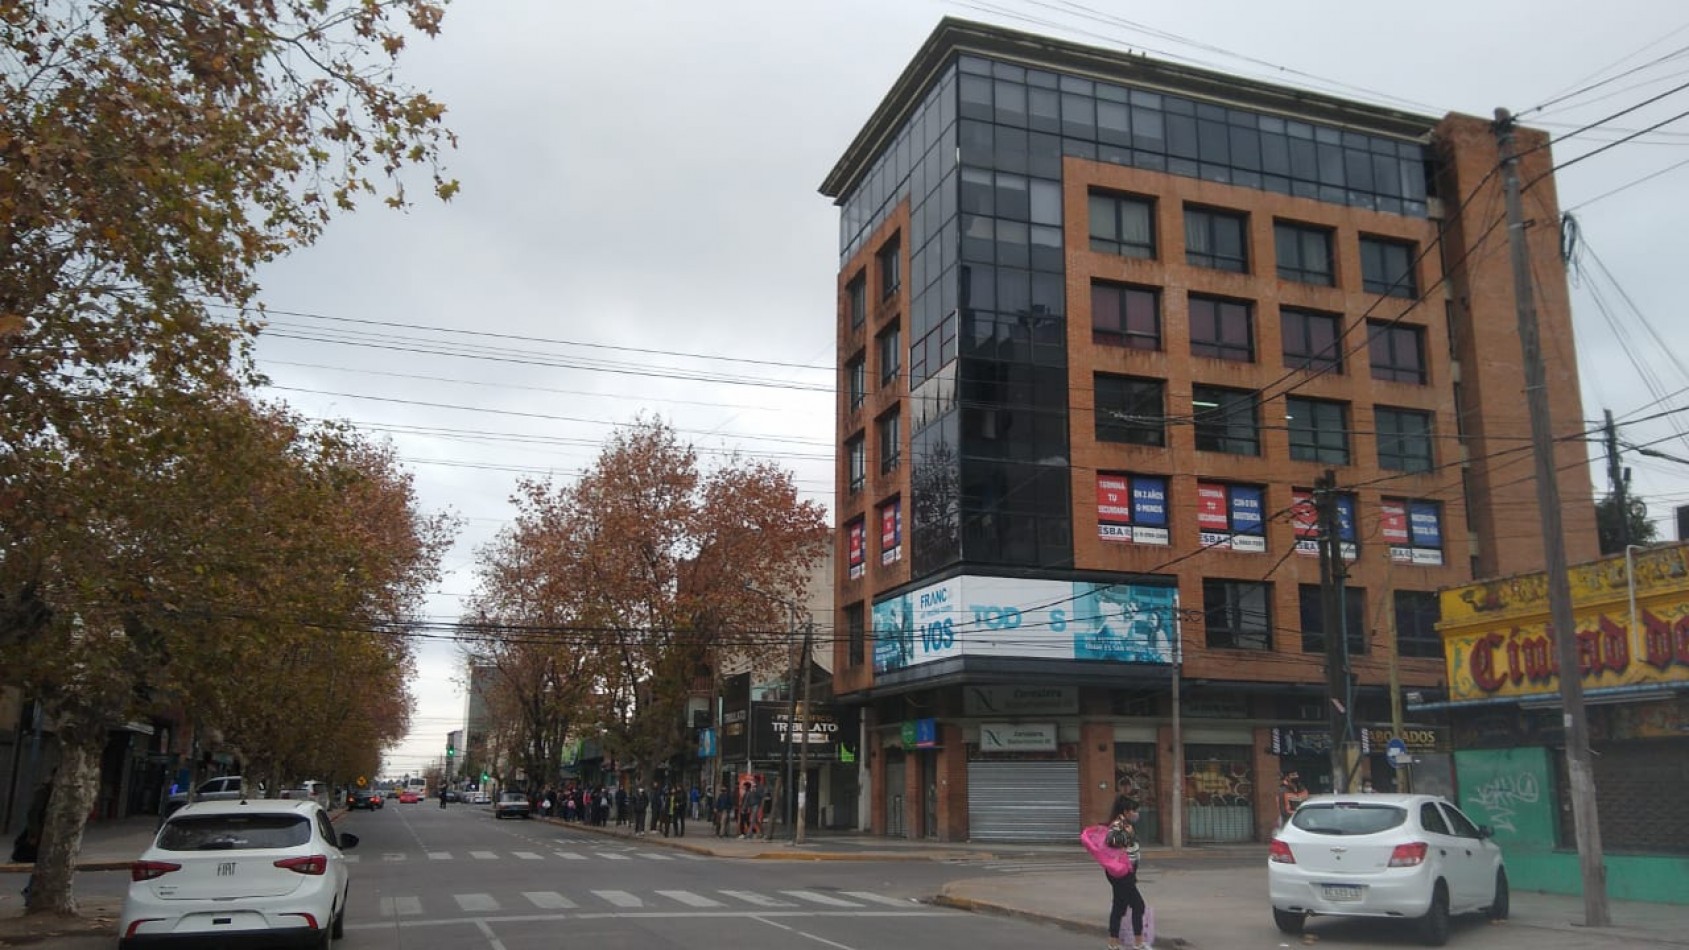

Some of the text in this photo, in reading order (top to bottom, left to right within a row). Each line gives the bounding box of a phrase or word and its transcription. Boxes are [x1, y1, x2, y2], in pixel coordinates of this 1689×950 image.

[1108, 493, 1118, 502] TU
[920, 617, 954, 653] VOS
[771, 722, 838, 732] TRBLATO
[1369, 730, 1436, 744] ABOADOS
[217, 862, 237, 876] FIAT
